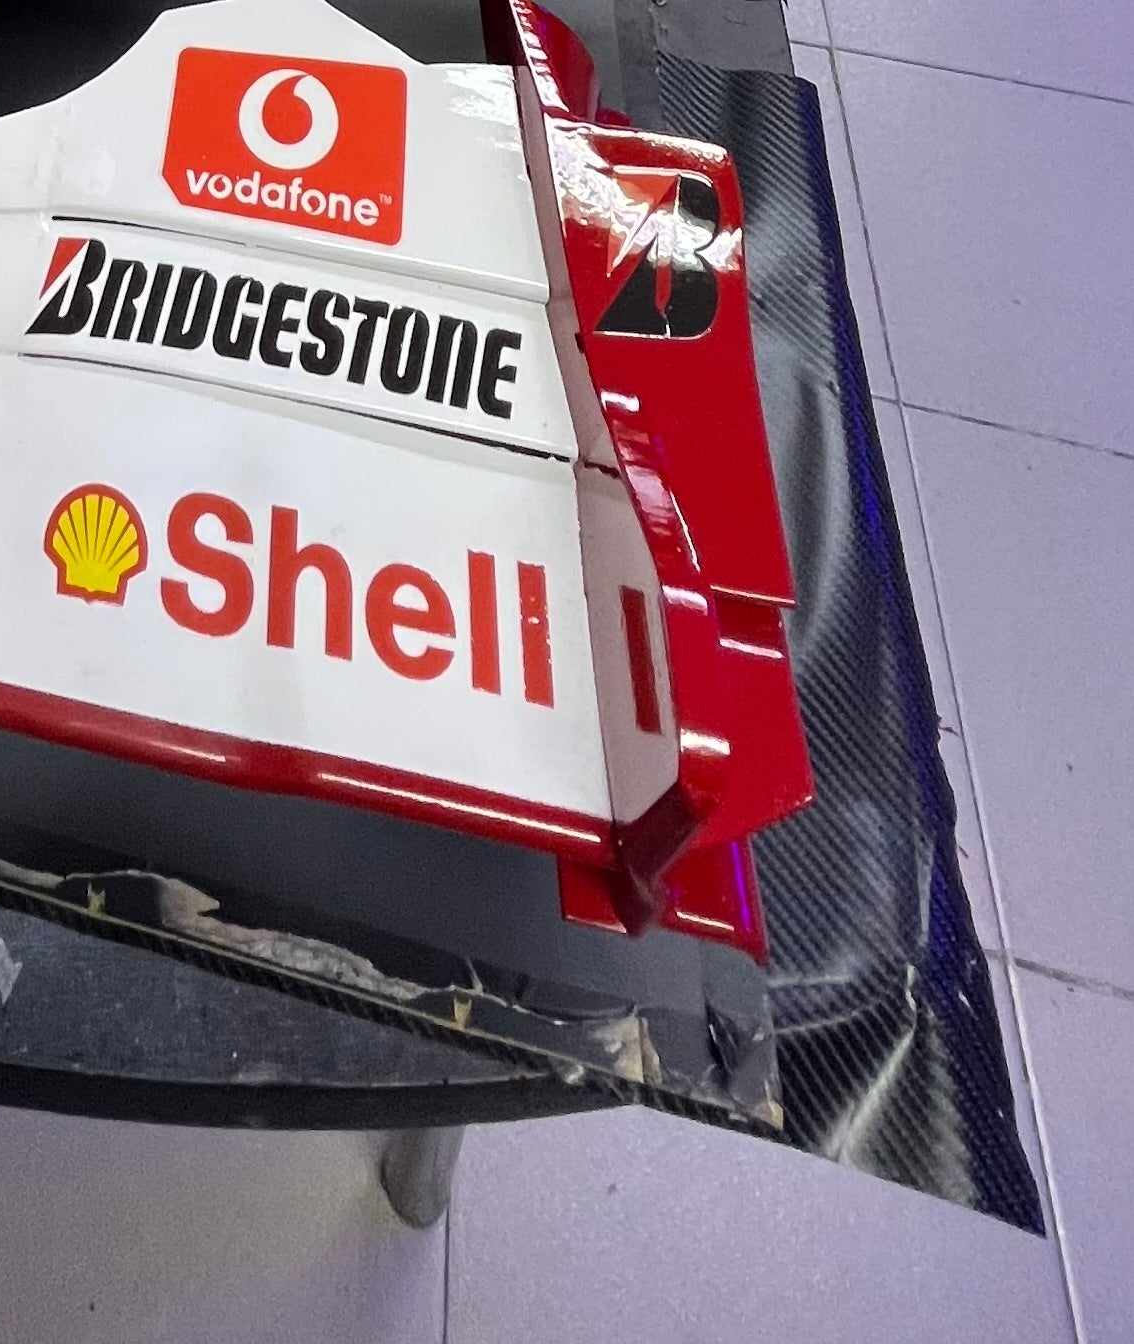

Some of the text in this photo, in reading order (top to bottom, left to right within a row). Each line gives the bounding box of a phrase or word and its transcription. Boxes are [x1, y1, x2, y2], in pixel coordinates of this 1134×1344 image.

[185, 169, 380, 227] vodafone
[25, 236, 523, 421] BRIDGESTONE
[160, 491, 555, 709] Shell
